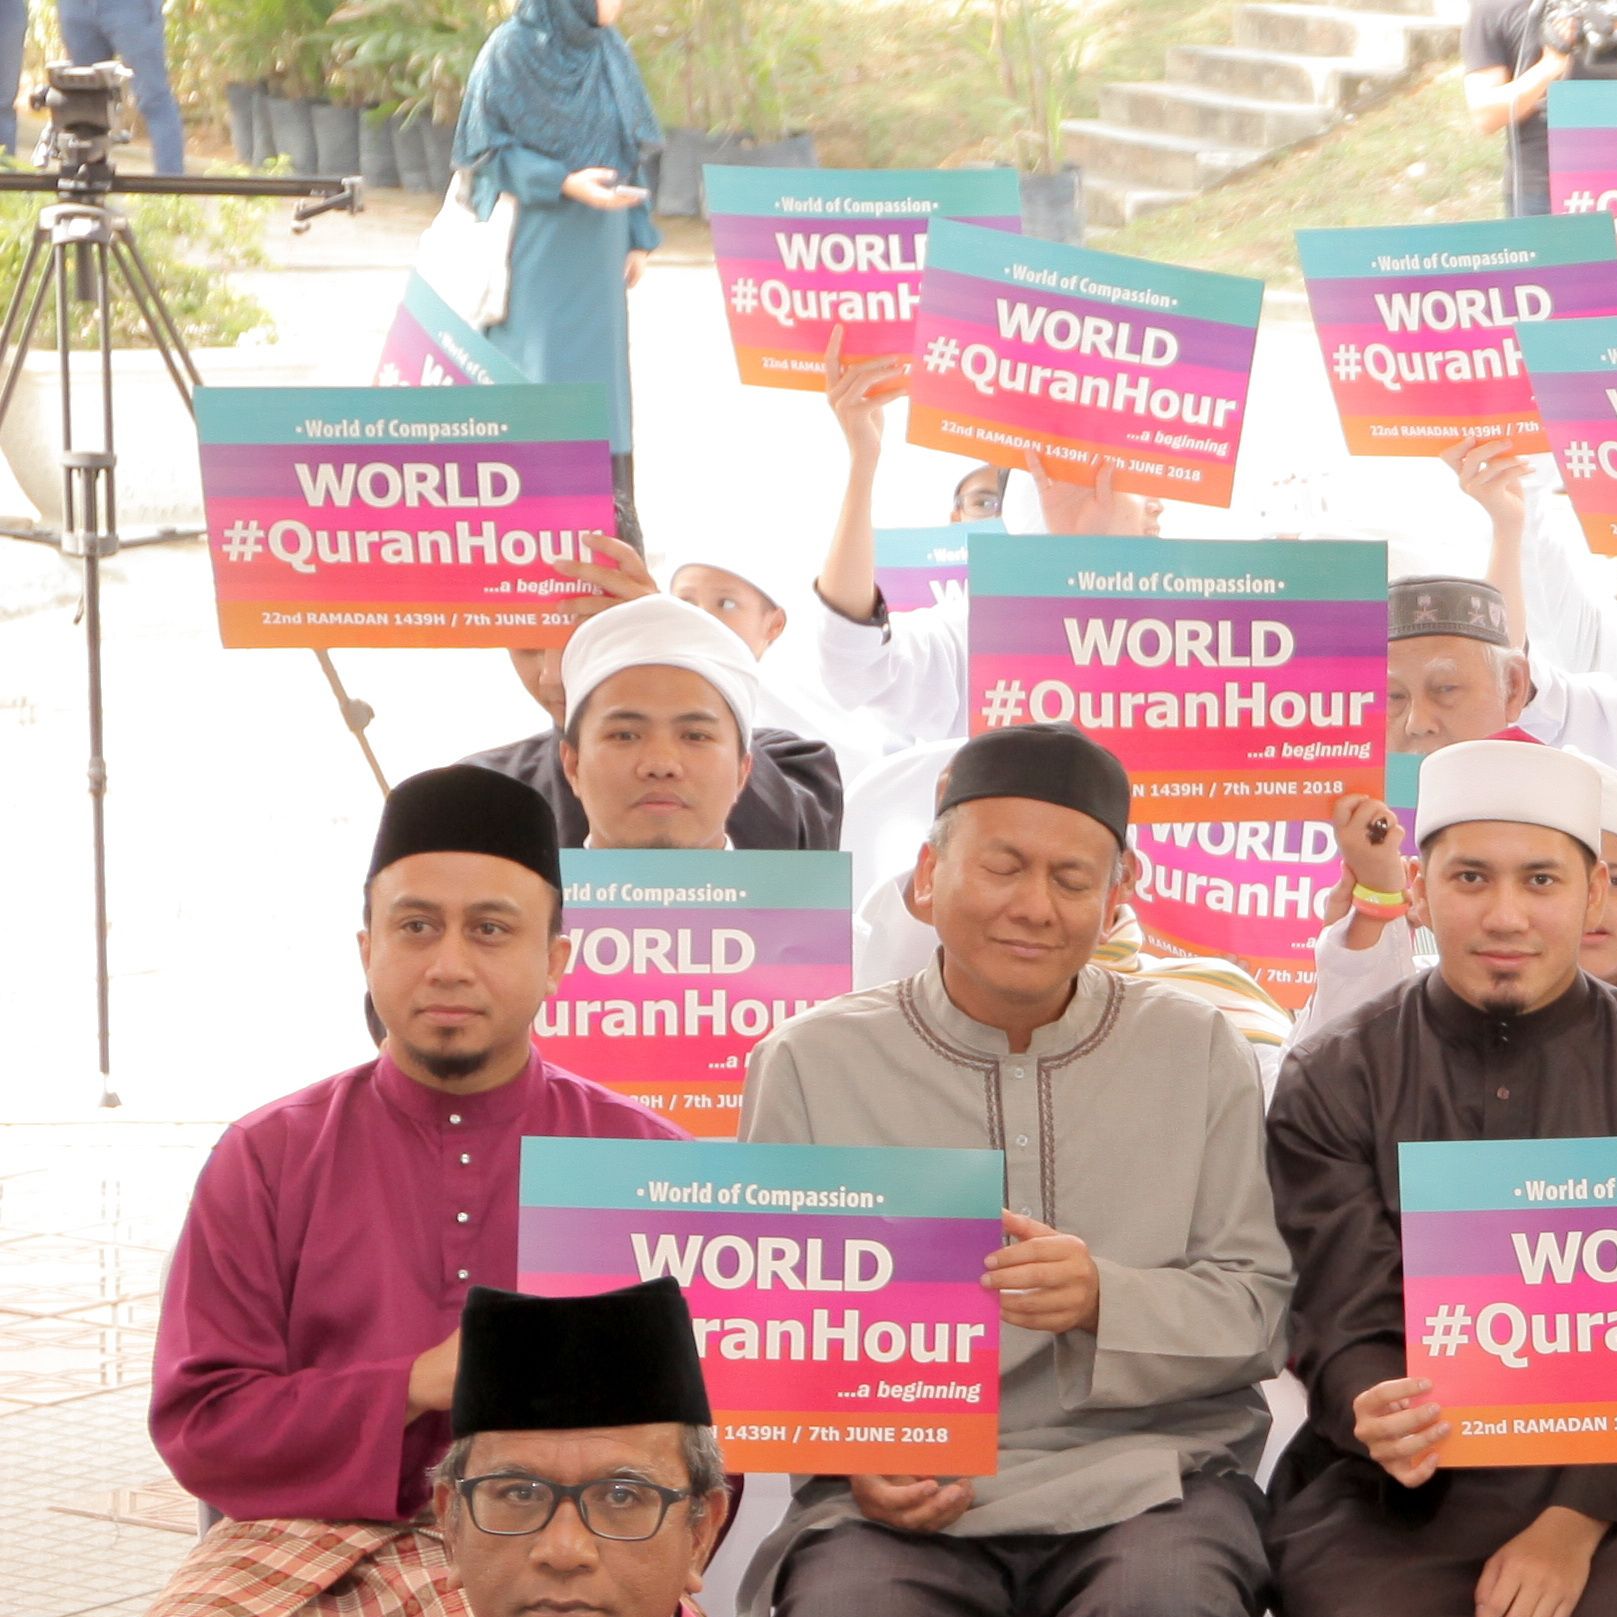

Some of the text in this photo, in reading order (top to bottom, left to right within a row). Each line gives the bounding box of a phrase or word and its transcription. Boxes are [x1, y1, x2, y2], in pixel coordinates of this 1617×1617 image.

[1375, 284, 1553, 333] WORLD
[996, 297, 1179, 368] WORLD
[923, 335, 1237, 428] #QuranHour
[305, 417, 501, 441] World of Compassion
[294, 461, 521, 508] WORLD
[1063, 617, 1294, 668] WORLD
[981, 679, 1374, 729] #QuranHour
[1150, 821, 1338, 864] WORLD
[648, 1181, 873, 1211] World of Compassion
[1525, 1178, 1588, 1201] World
[1593, 1177, 1616, 1199] of
[630, 1232, 894, 1293] WORLD
[876, 1380, 982, 1403] beginning
[724, 1425, 949, 1444] 1439H 7th JUNE 2018
[1461, 1418, 1507, 1436] 22nd
[1512, 1415, 1608, 1433] RAMADAN
